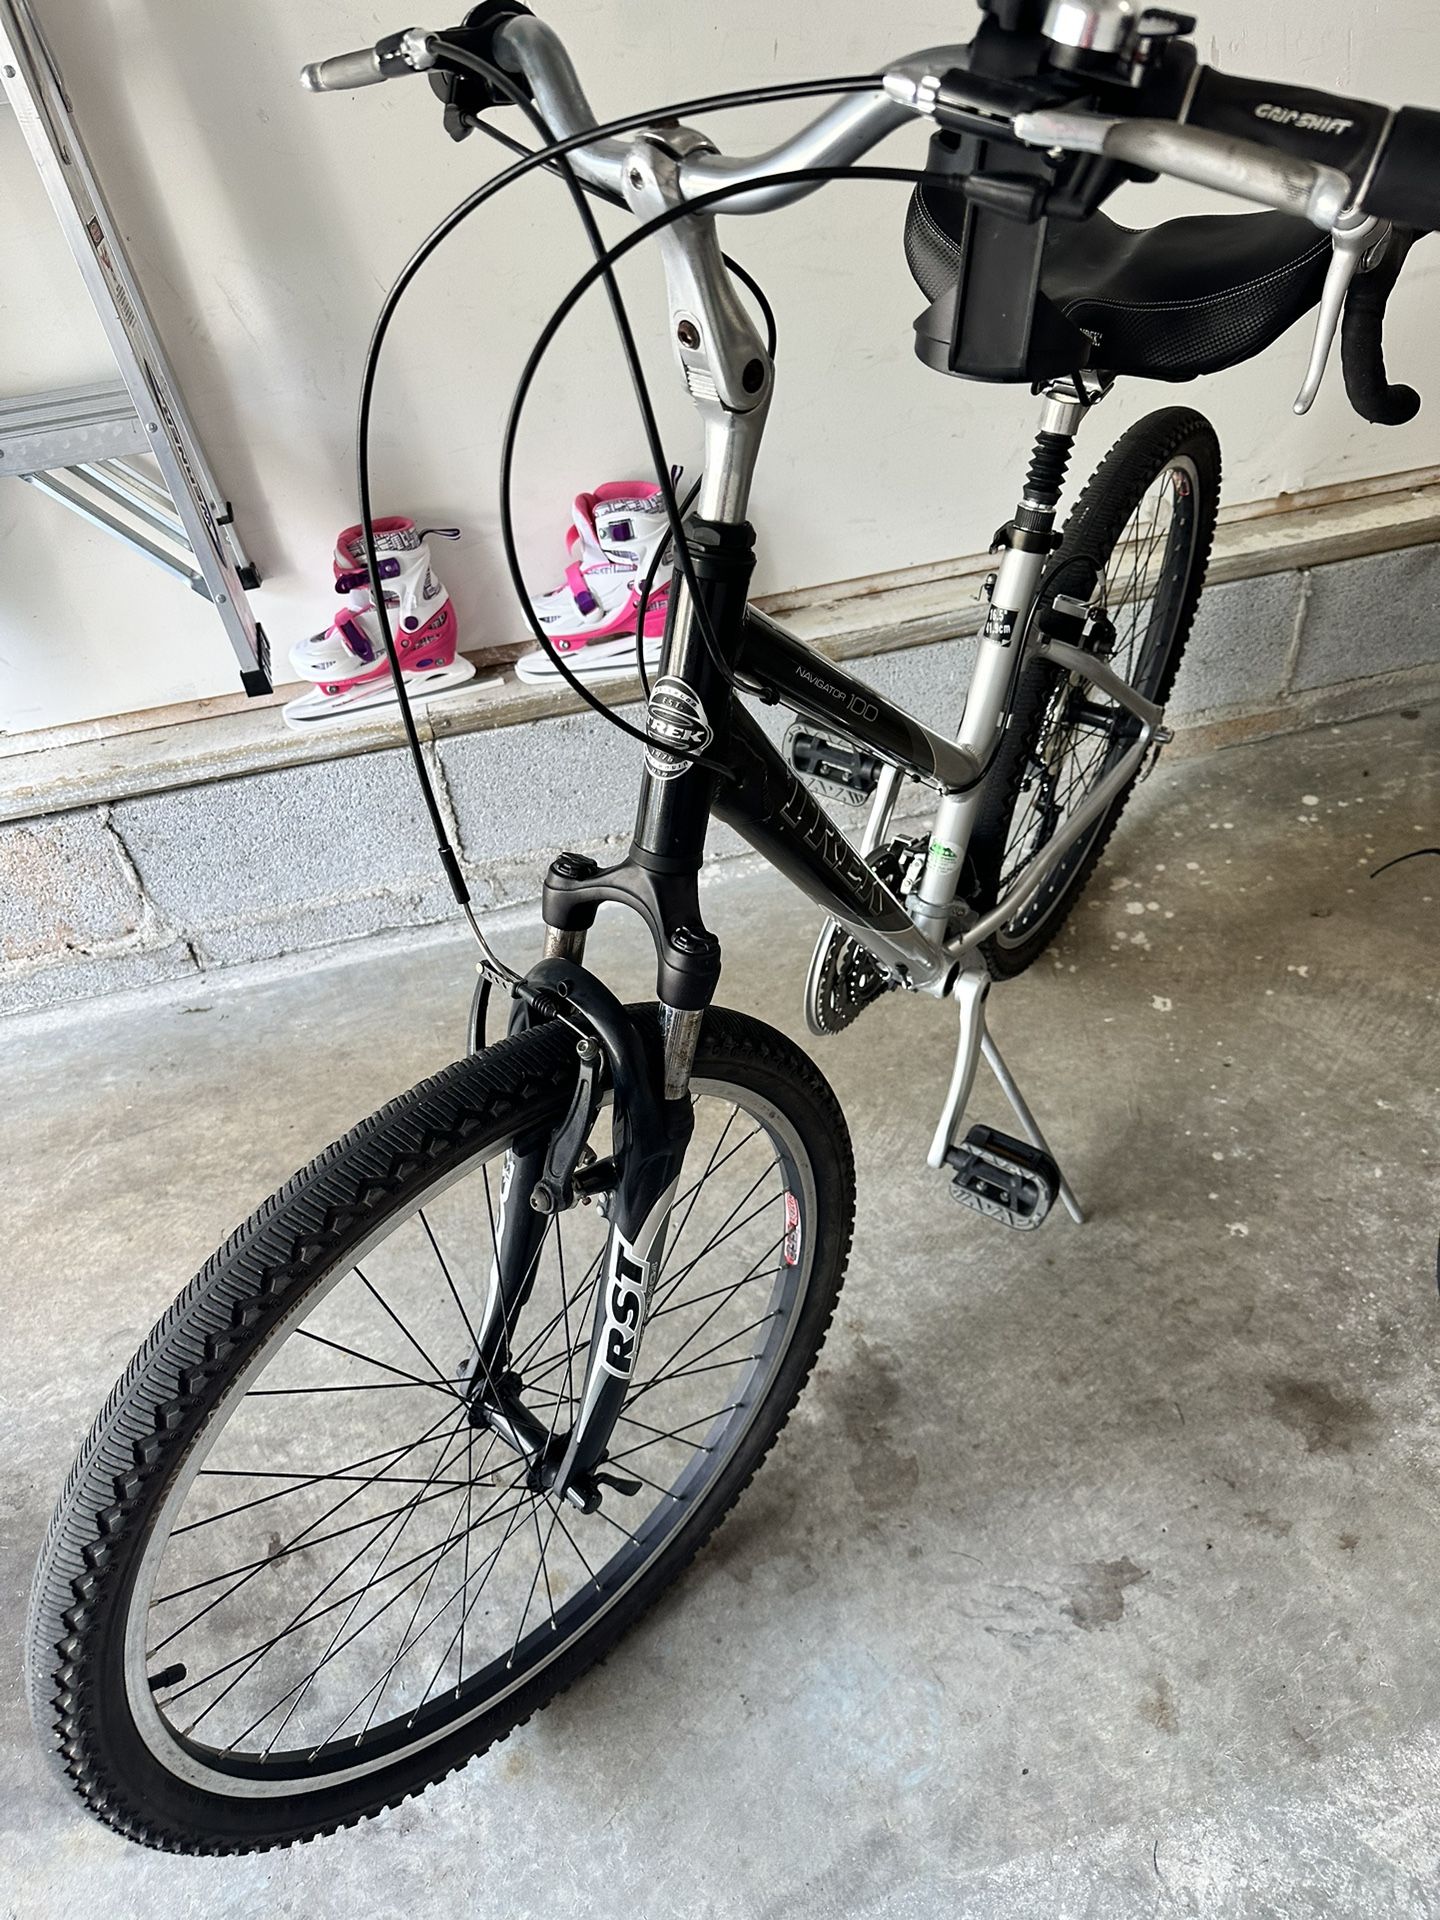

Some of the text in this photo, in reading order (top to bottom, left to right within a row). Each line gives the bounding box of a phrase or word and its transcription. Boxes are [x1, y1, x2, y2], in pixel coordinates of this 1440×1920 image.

[160, 403, 213, 527] WERNER
[647, 717, 704, 743] TREK
[795, 666, 879, 722] NAVIGATOR 100
[779, 779, 883, 916] TREK
[603, 1236, 648, 1377] RST
